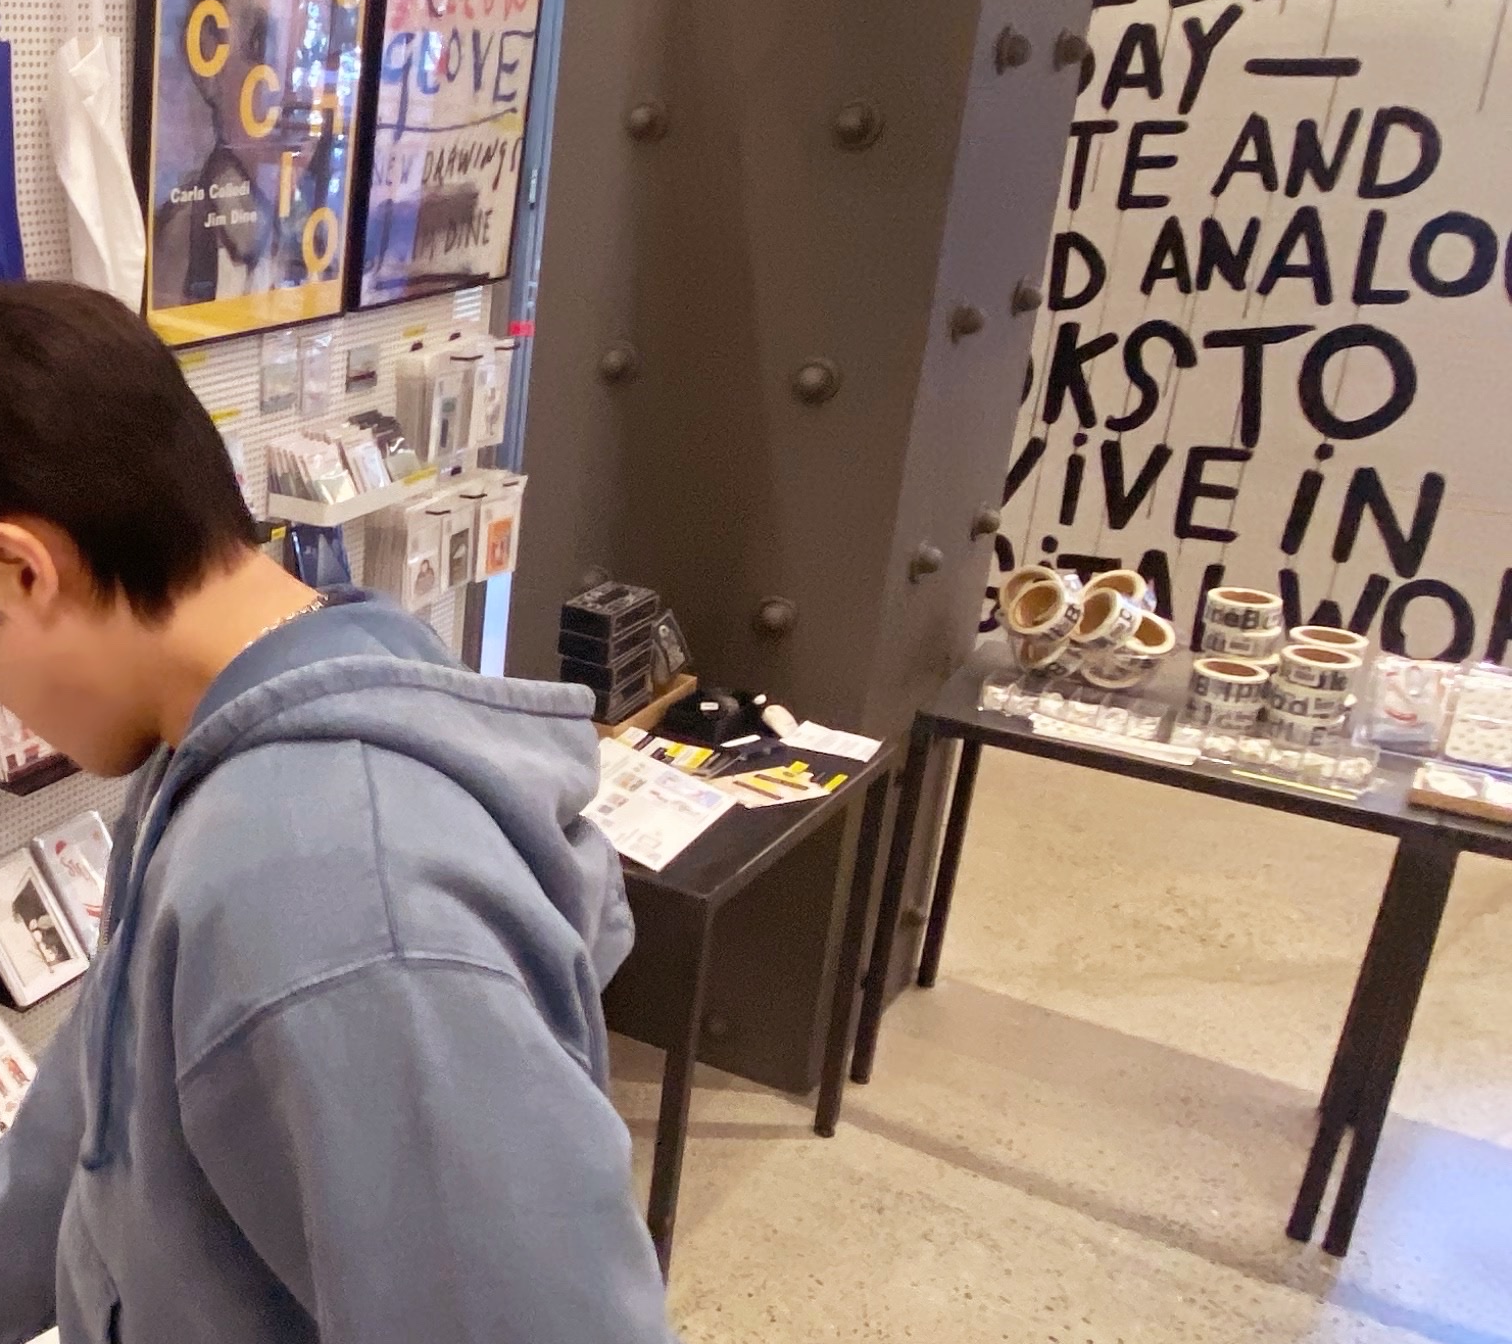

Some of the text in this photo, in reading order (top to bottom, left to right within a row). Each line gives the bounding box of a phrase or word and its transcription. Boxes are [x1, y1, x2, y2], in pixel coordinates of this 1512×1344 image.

[170, 185, 205, 203] Carlo
[1068, 106, 1442, 212] TE AND
[204, 209, 258, 228] Jim Dine
[1048, 204, 1512, 311] D ANALO
[1021, 318, 1417, 449] KS TO
